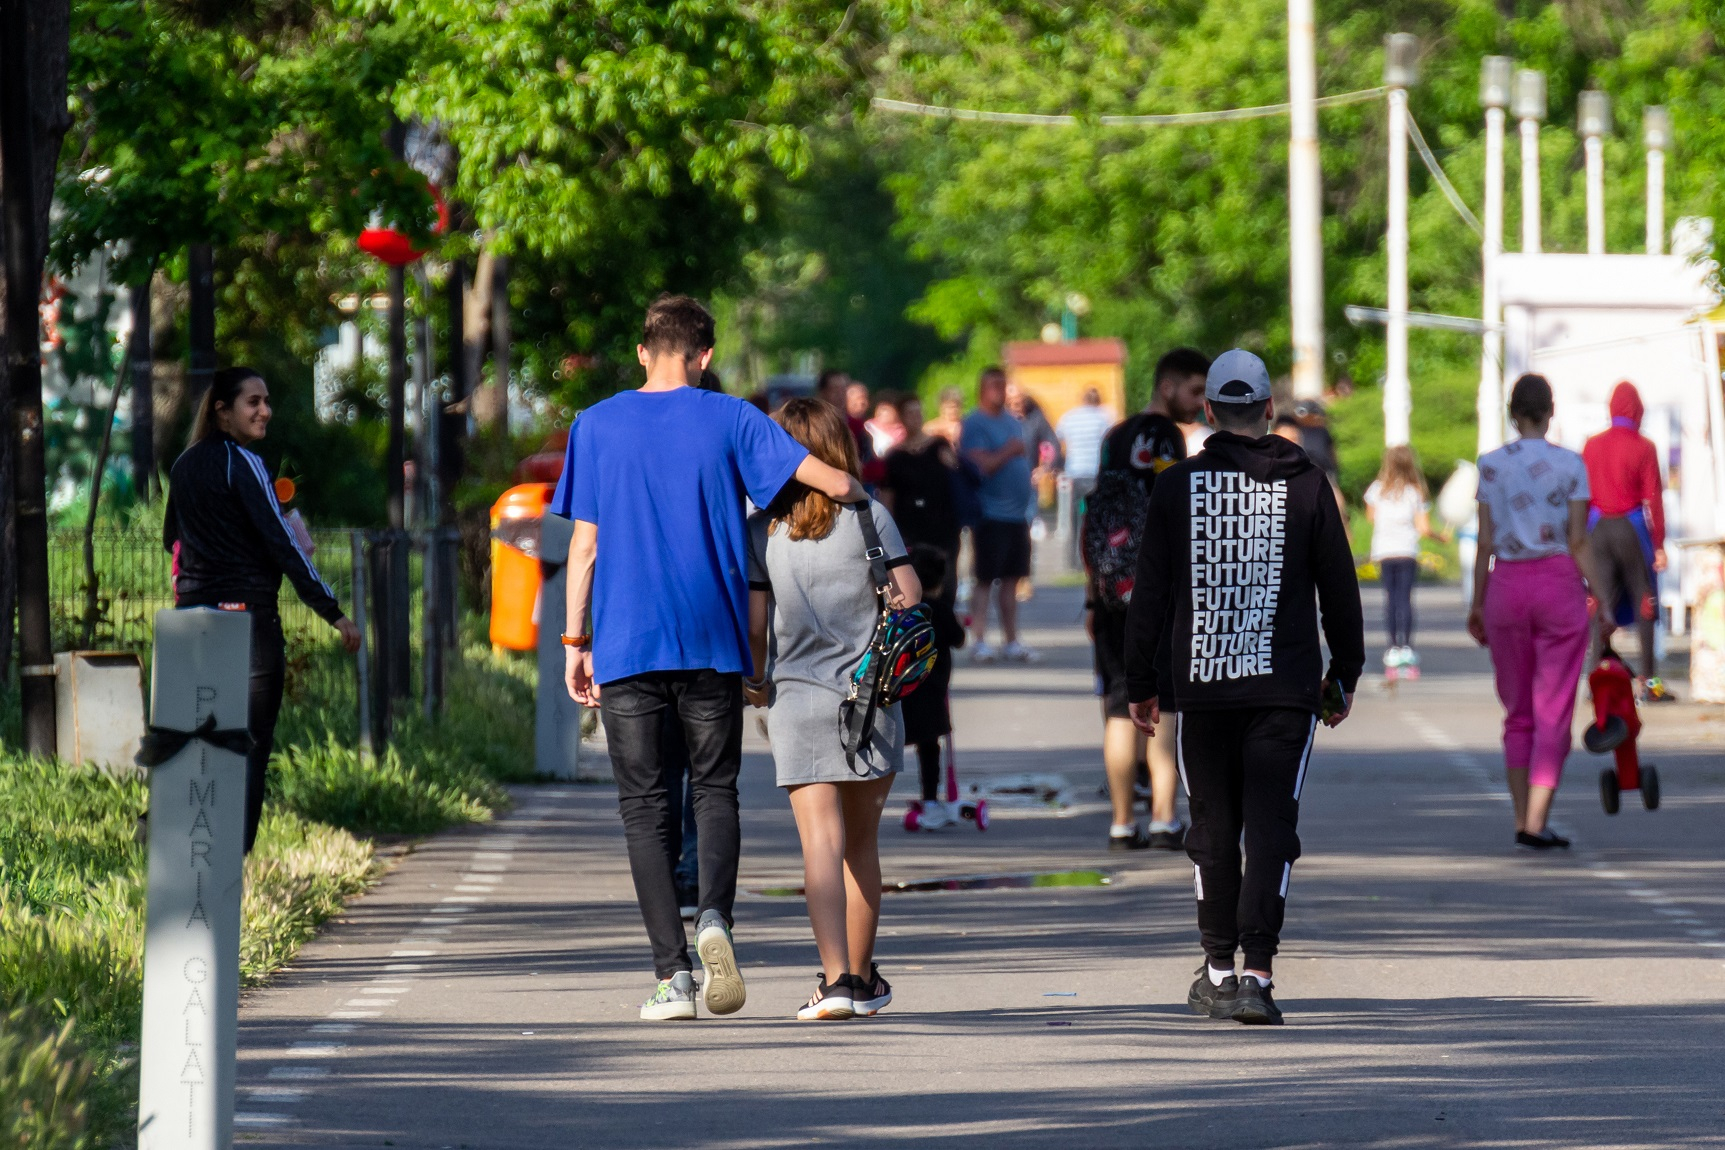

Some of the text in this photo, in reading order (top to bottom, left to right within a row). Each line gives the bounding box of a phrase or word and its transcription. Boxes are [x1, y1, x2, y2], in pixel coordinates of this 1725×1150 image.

[1190, 492, 1288, 516] FUTURE
[1190, 514, 1286, 540] FUTURE
[1190, 538, 1285, 563] FUTURE
[1191, 562, 1283, 587] FUTURE
[1191, 586, 1280, 611] FUTURE
[1192, 609, 1276, 635] FUTURE
[1191, 631, 1273, 658] FUTURE
[1189, 652, 1273, 683] FUTURE
[180, 956, 208, 1139] GALATI
